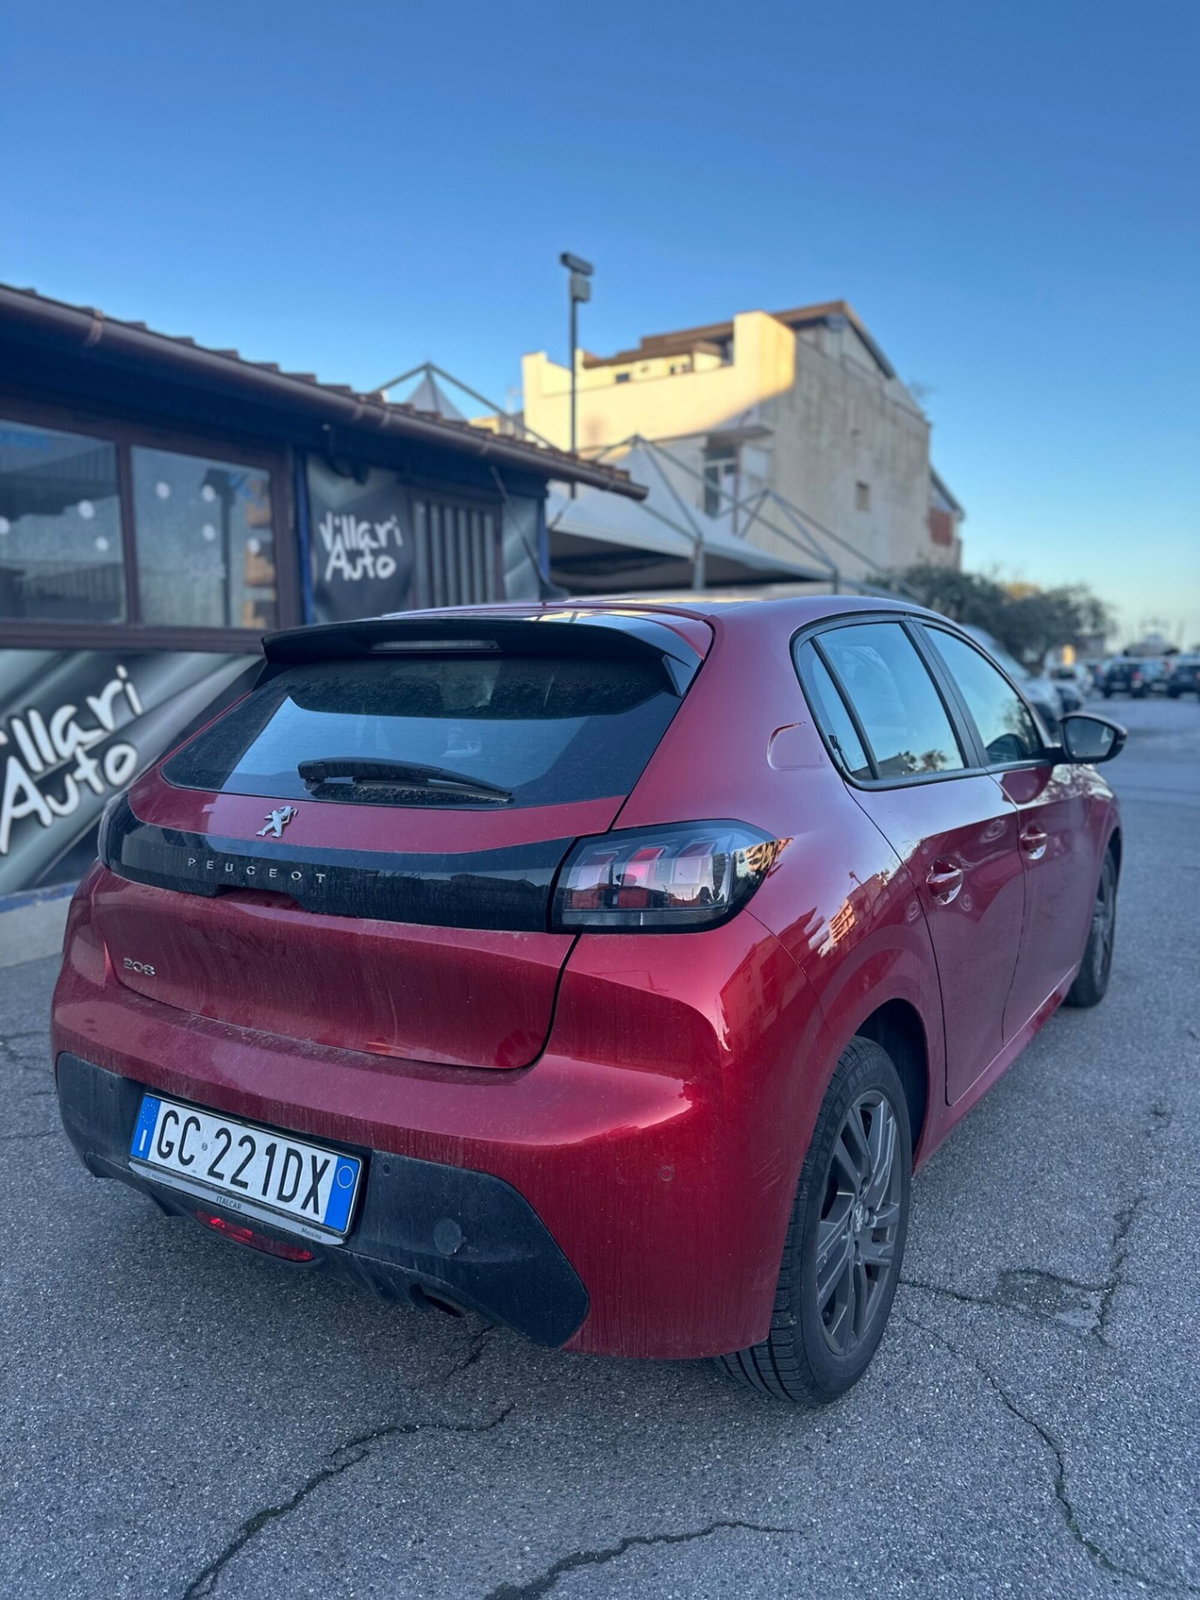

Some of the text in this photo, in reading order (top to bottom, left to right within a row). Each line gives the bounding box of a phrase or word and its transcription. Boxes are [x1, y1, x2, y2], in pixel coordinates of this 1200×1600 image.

[319, 511, 403, 552] Villari
[325, 533, 397, 582] Auto
[0, 665, 143, 772] illari
[0, 744, 138, 854] Auto
[188, 857, 326, 884] PEUGEOT
[123, 957, 156, 976] 208
[216, 1195, 242, 1211] ITALCAR
